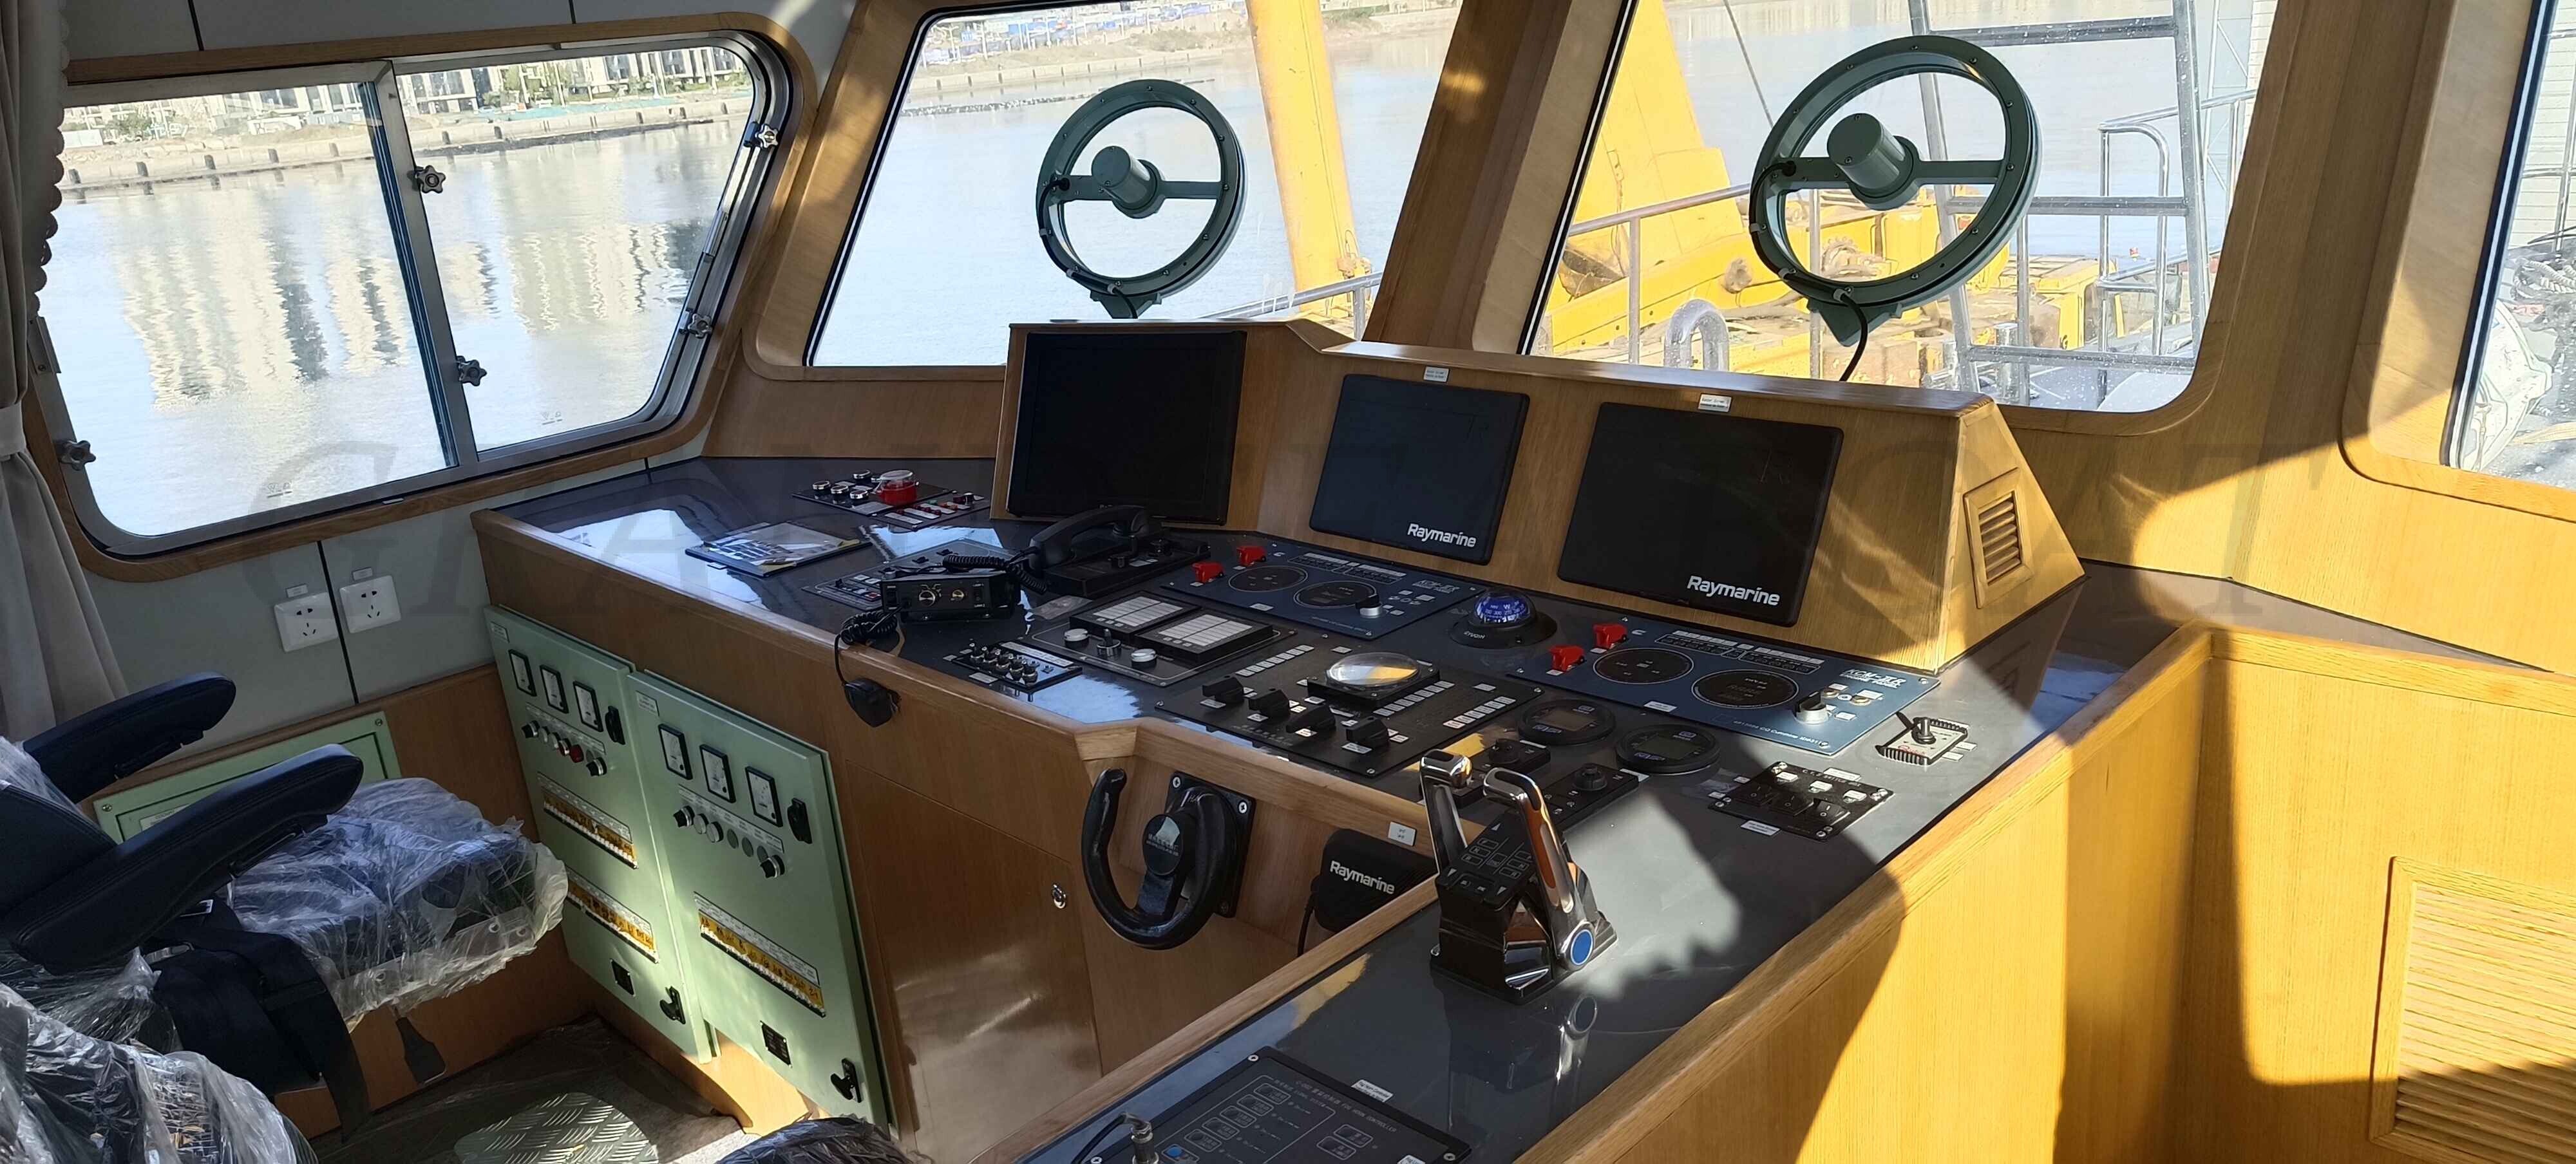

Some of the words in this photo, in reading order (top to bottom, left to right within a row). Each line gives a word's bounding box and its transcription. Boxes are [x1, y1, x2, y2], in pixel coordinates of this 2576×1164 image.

[1407, 523, 1477, 548] Raymarine
[1686, 575, 1781, 606] Raymarine
[1330, 860, 1395, 895] Raymarine
